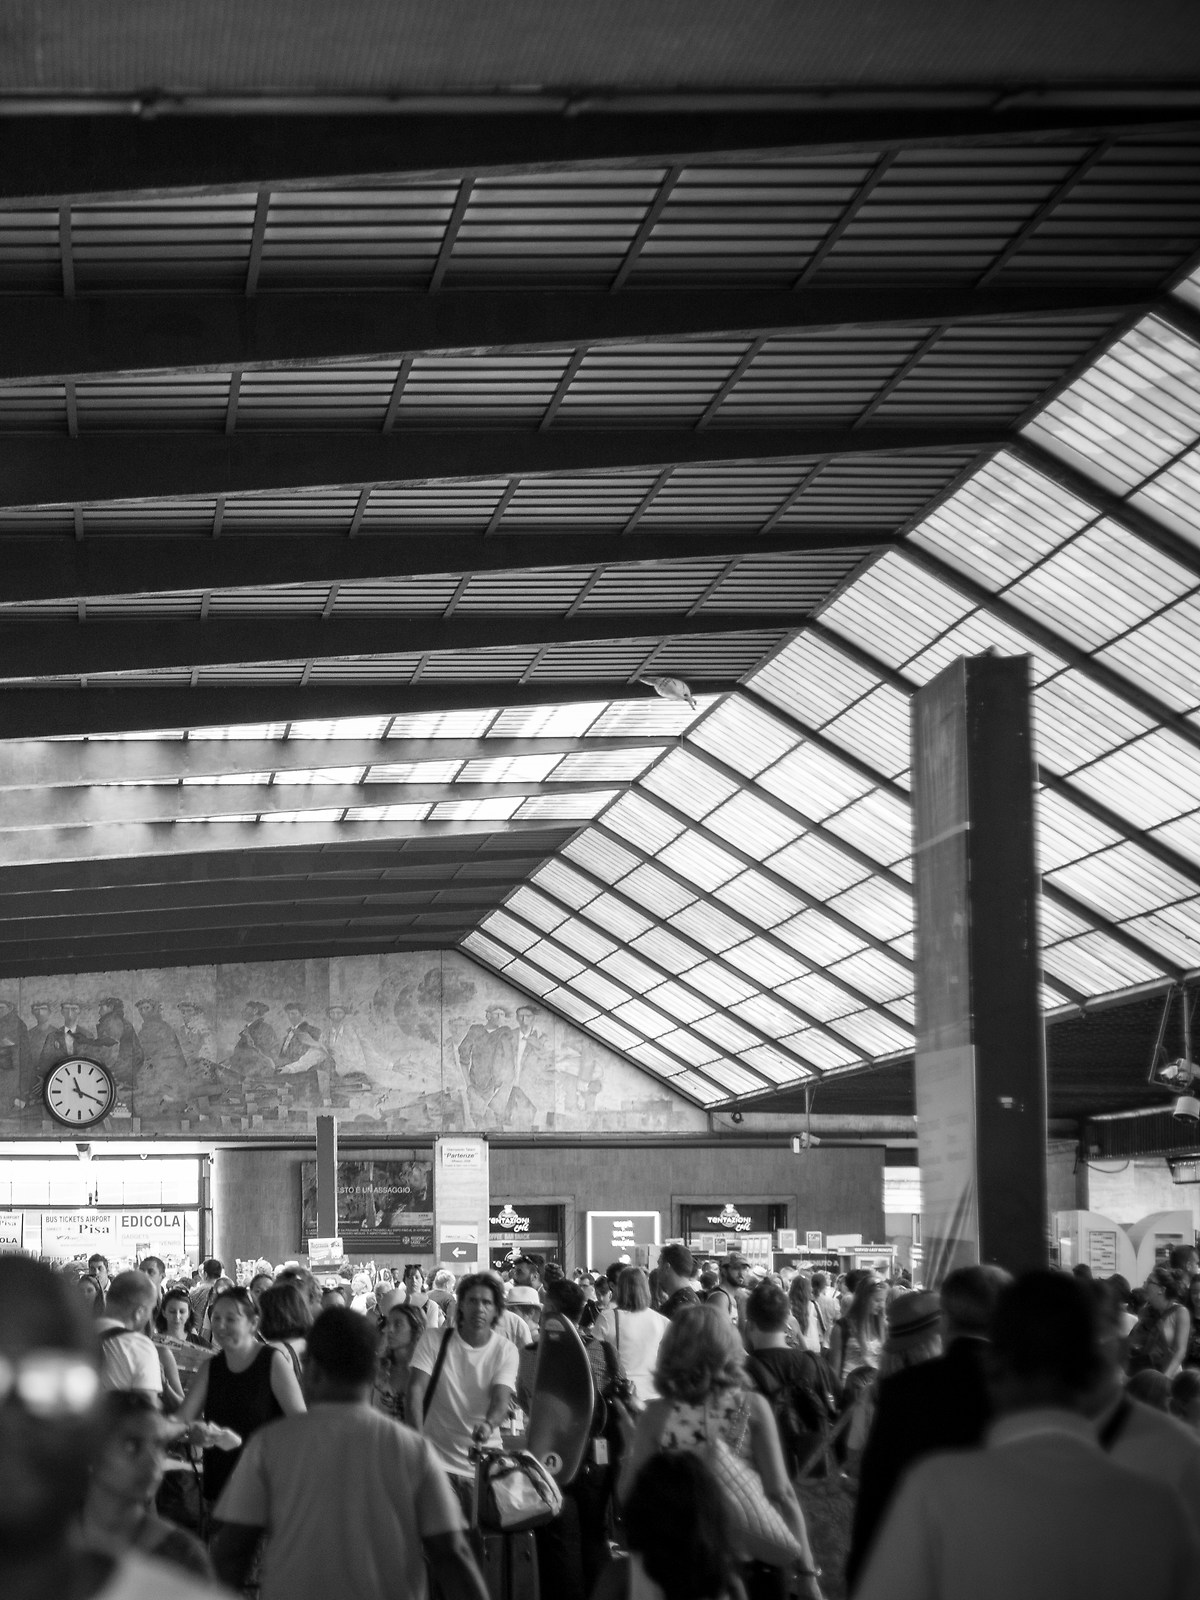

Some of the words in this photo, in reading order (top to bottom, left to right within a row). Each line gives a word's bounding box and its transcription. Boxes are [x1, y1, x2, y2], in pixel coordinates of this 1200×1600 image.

[45, 1215, 58, 1223] BUS
[59, 1215, 84, 1223] TICKETS
[85, 1215, 111, 1223] AIRPORT
[121, 1215, 181, 1228] EDICOLA
[489, 1215, 530, 1225] ENTAZIONI
[79, 1224, 110, 1234] Pisa
